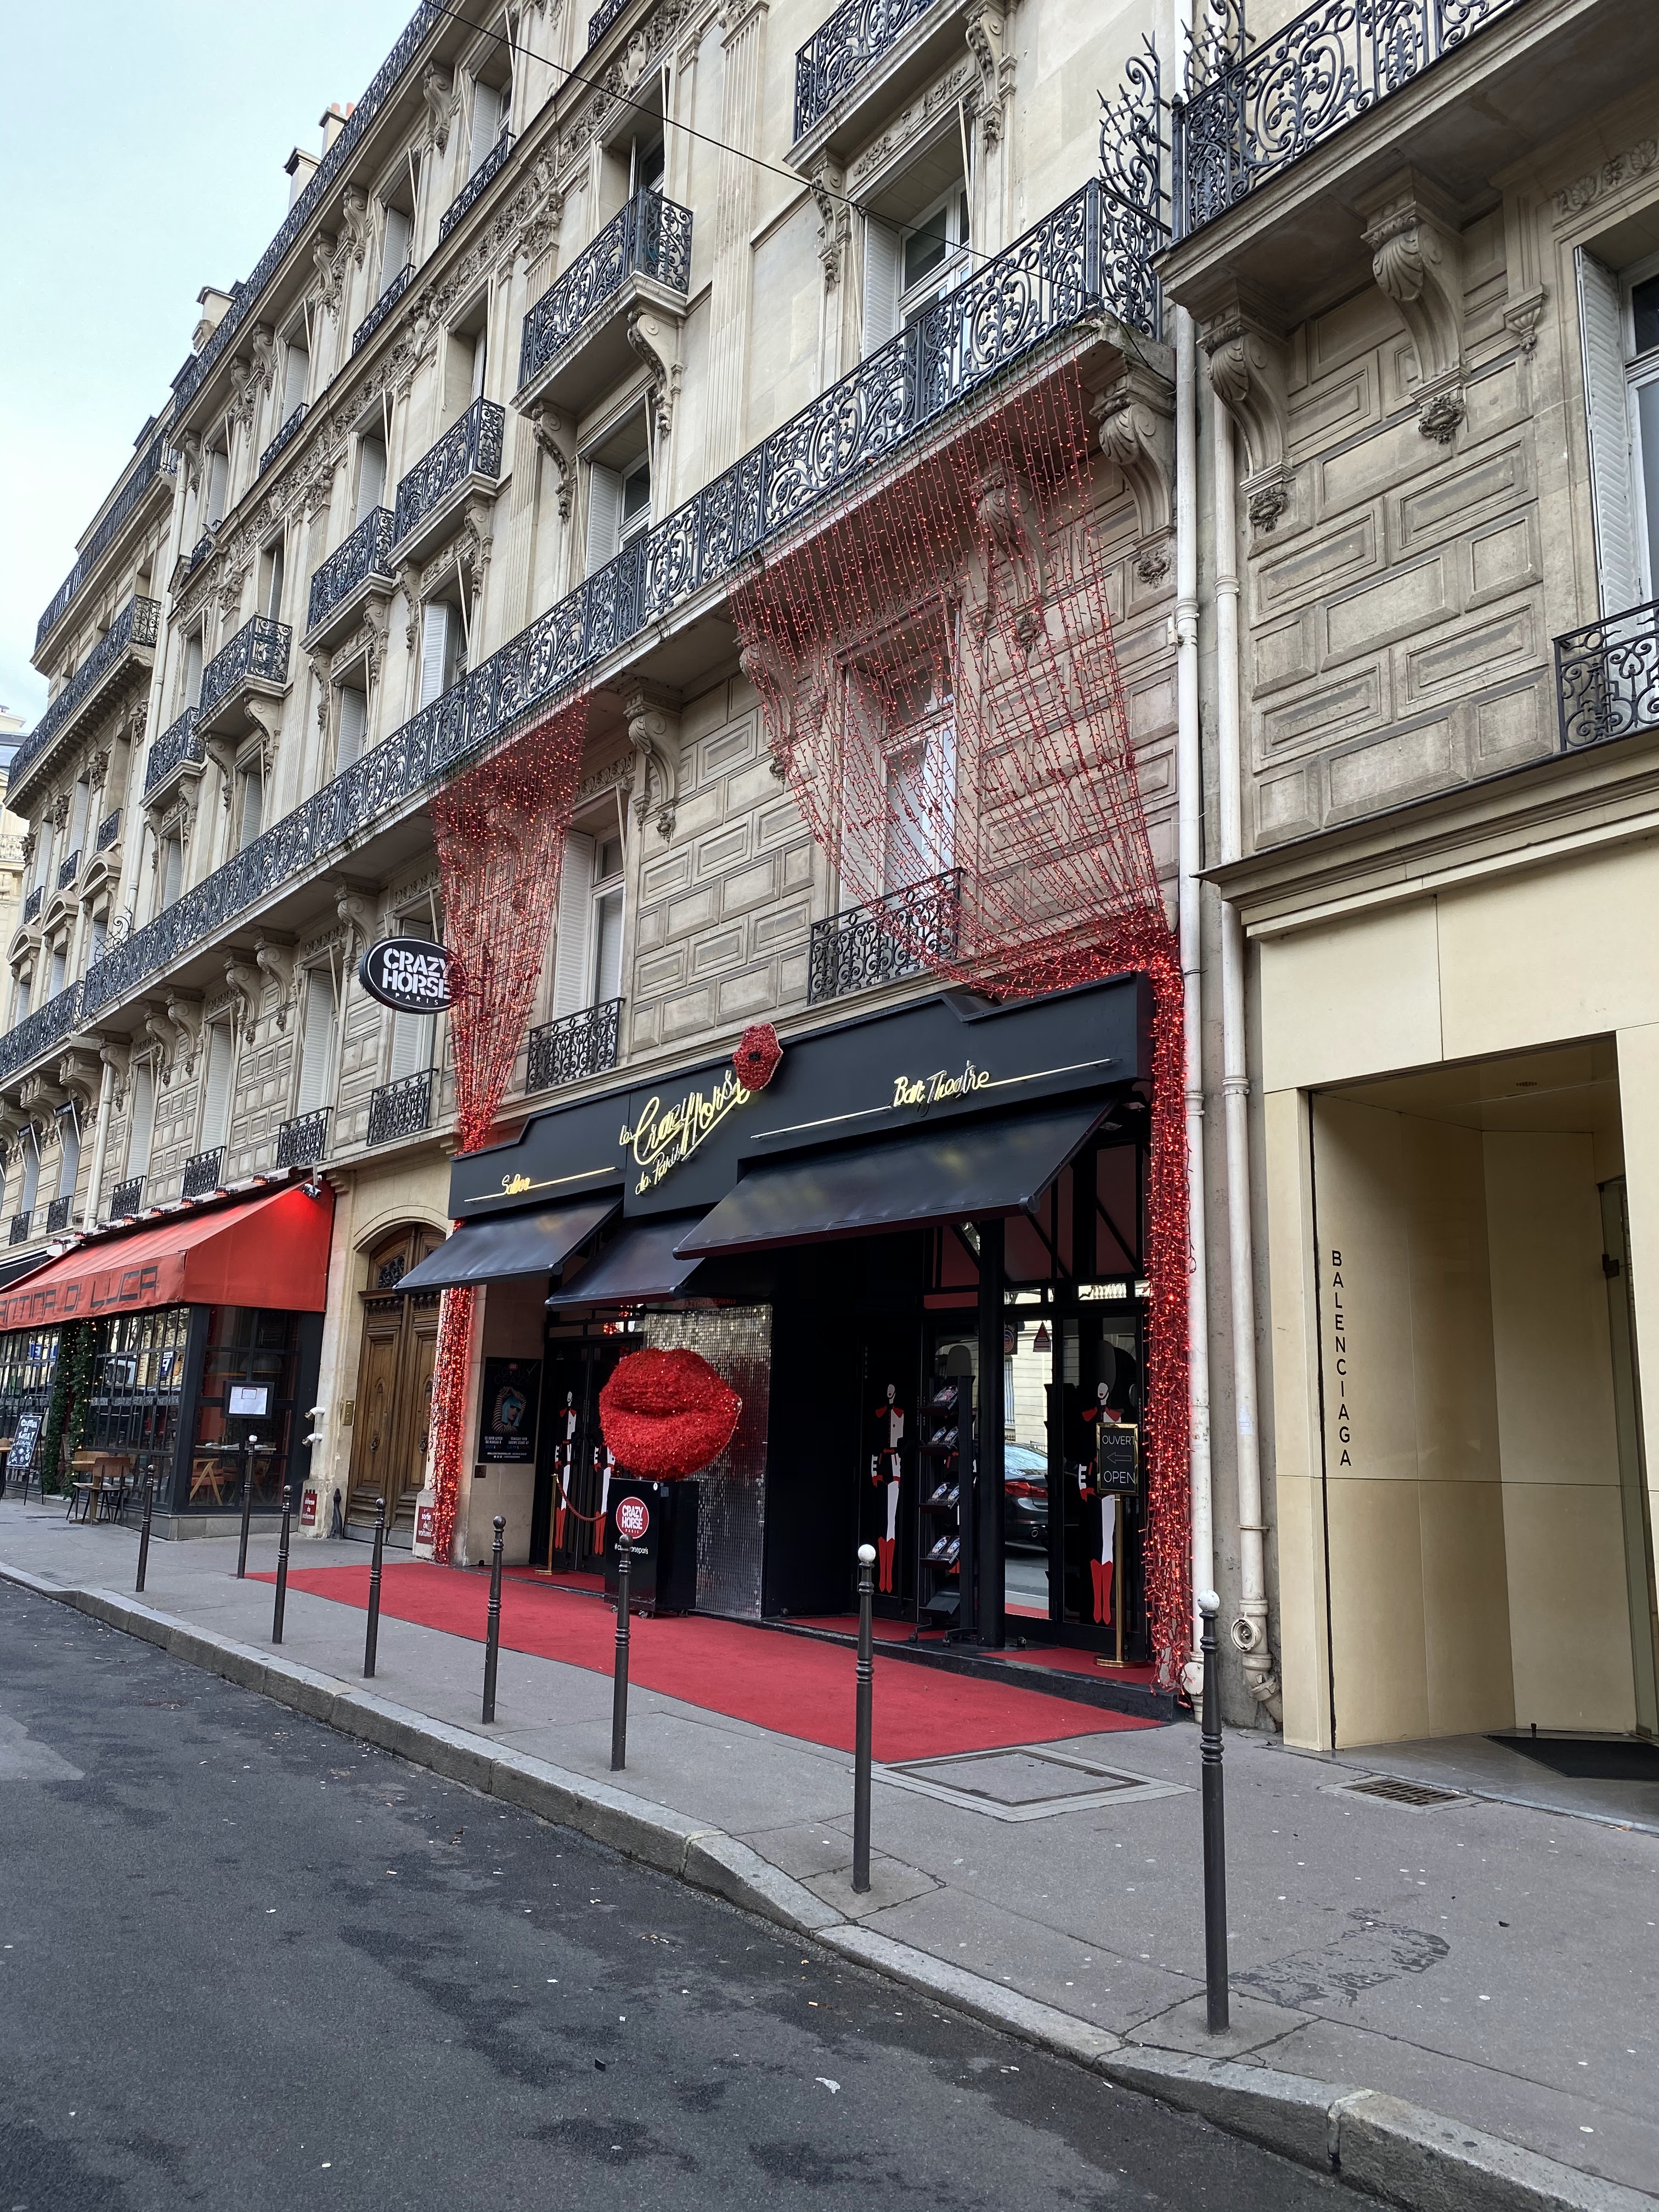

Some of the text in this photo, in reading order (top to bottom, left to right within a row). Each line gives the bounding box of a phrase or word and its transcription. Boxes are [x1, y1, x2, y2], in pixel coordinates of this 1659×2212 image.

[383, 948, 450, 979] CRAZY
[382, 968, 452, 1000] HORSE
[395, 992, 438, 1006] PARIS
[652, 1144, 681, 1185] Paris
[90, 1266, 158, 1308] LUCA
[1332, 1250, 1351, 1466] BALENCIAGA
[1102, 1435, 1135, 1445] OUVERT
[1104, 1471, 1135, 1484] OPEN
[622, 1505, 644, 1519] CRAZY
[622, 1516, 643, 1530] HORSE
